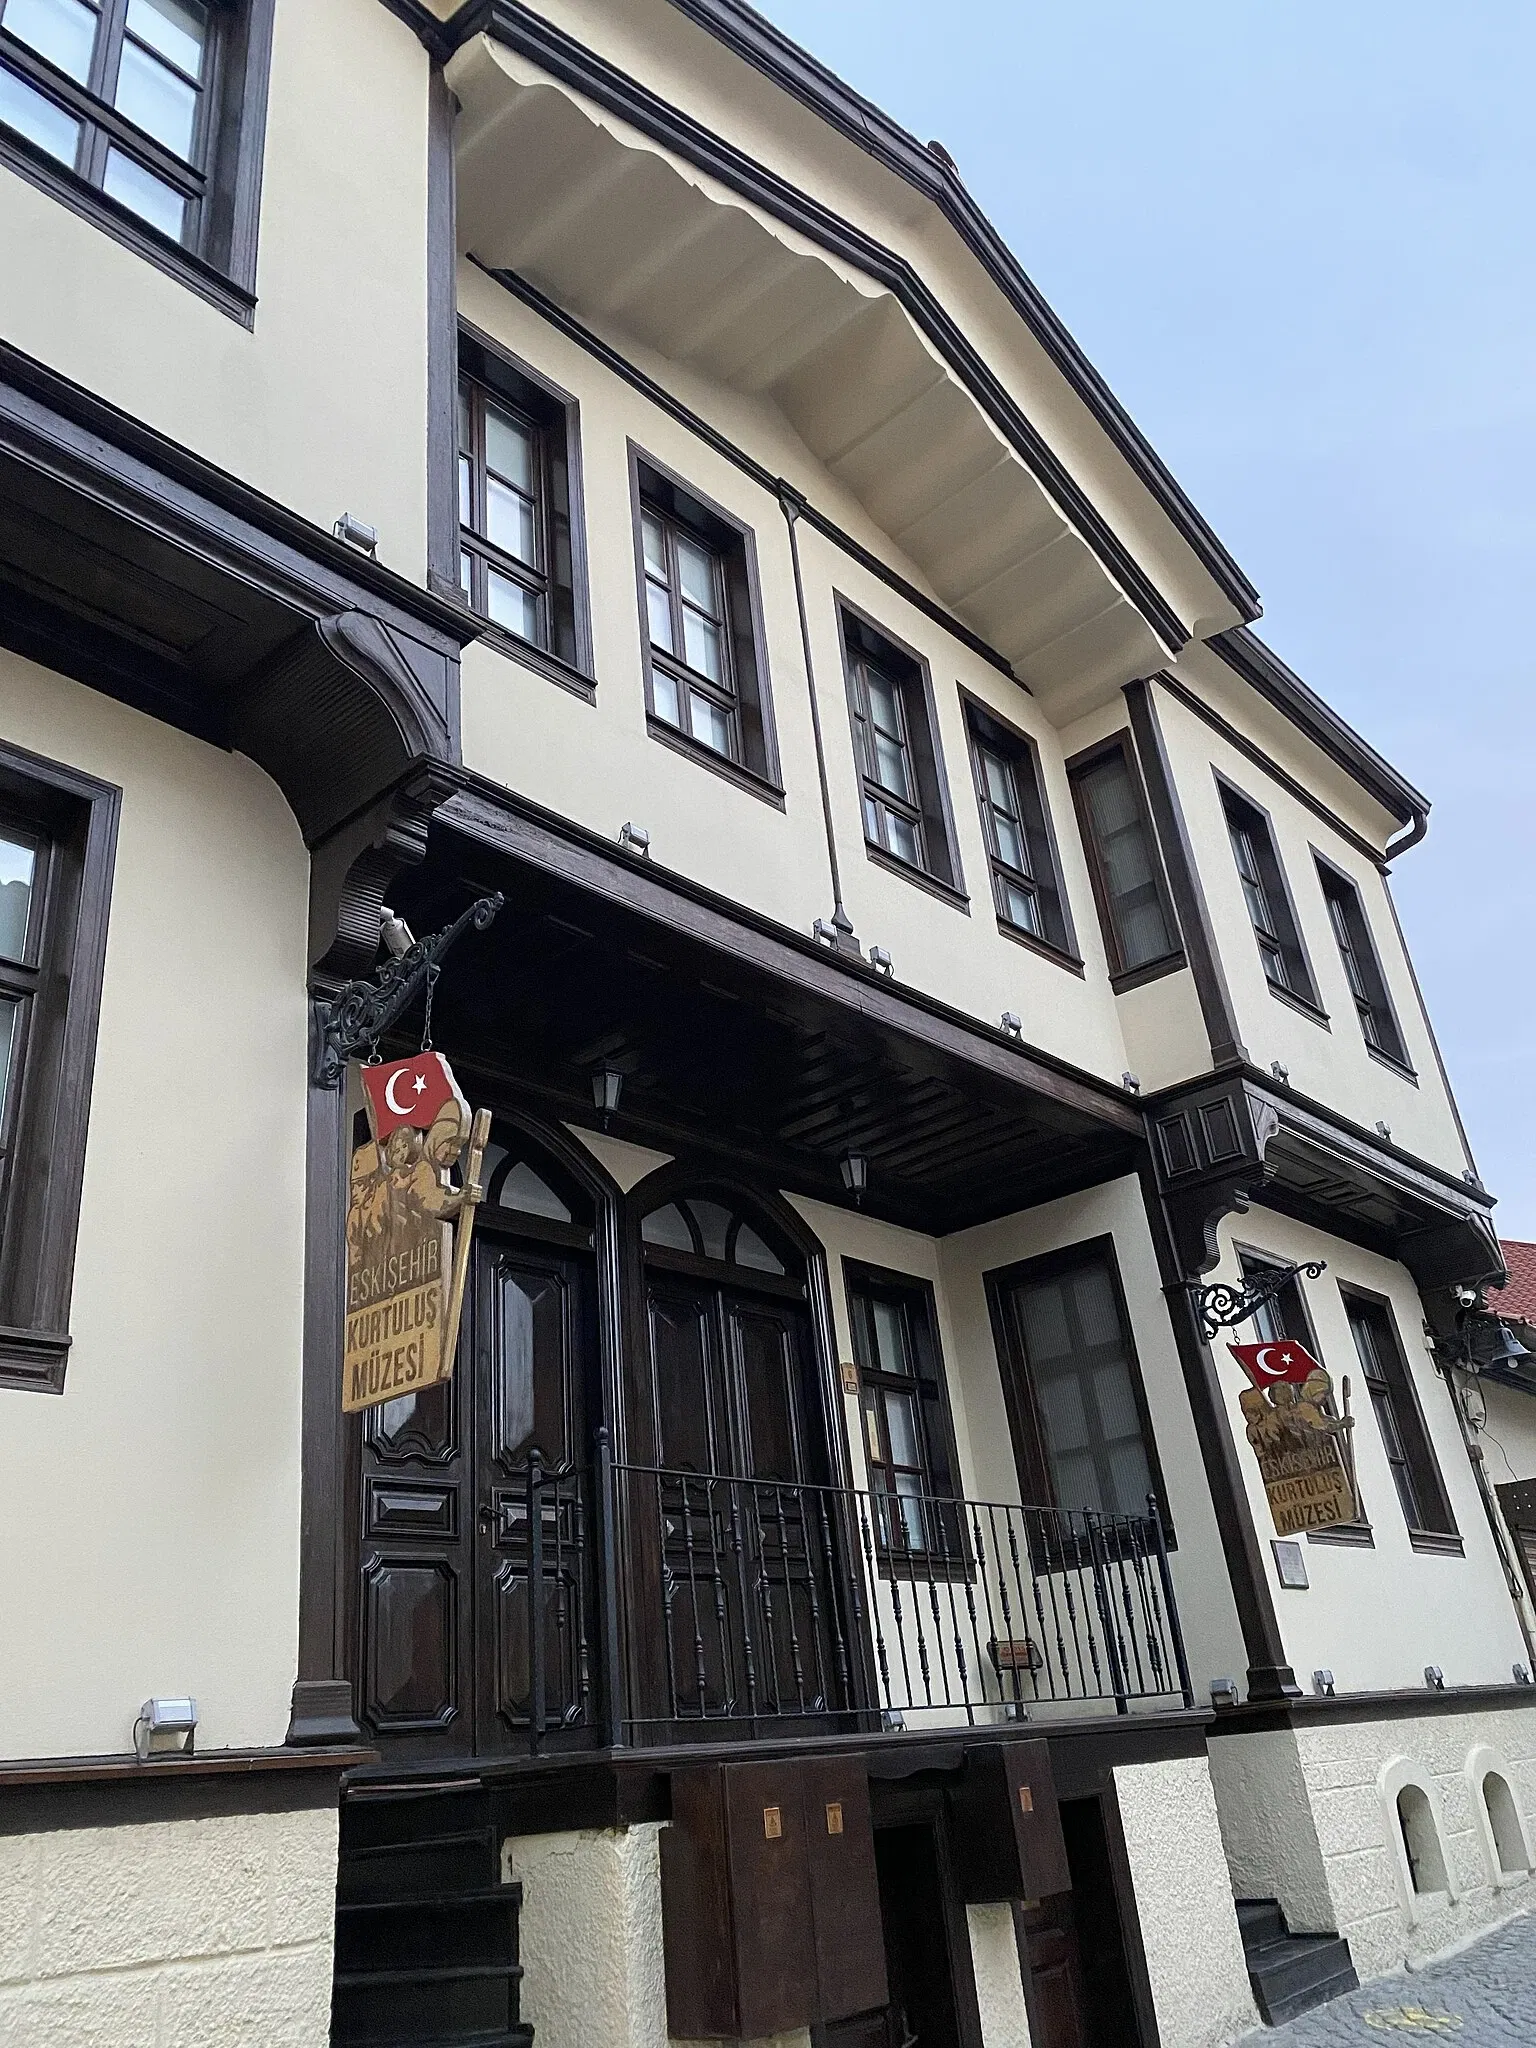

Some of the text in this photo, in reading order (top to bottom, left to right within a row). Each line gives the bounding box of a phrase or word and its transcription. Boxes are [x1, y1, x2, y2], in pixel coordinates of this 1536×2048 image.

[350, 1239, 439, 1305] ESKİŞEHİR
[347, 1287, 437, 1353] KURTULUŞ
[352, 1332, 424, 1401] MÜZESİ
[1267, 1471, 1342, 1505] KURTULUŞ
[1280, 1497, 1342, 1531] MÜZESİ
